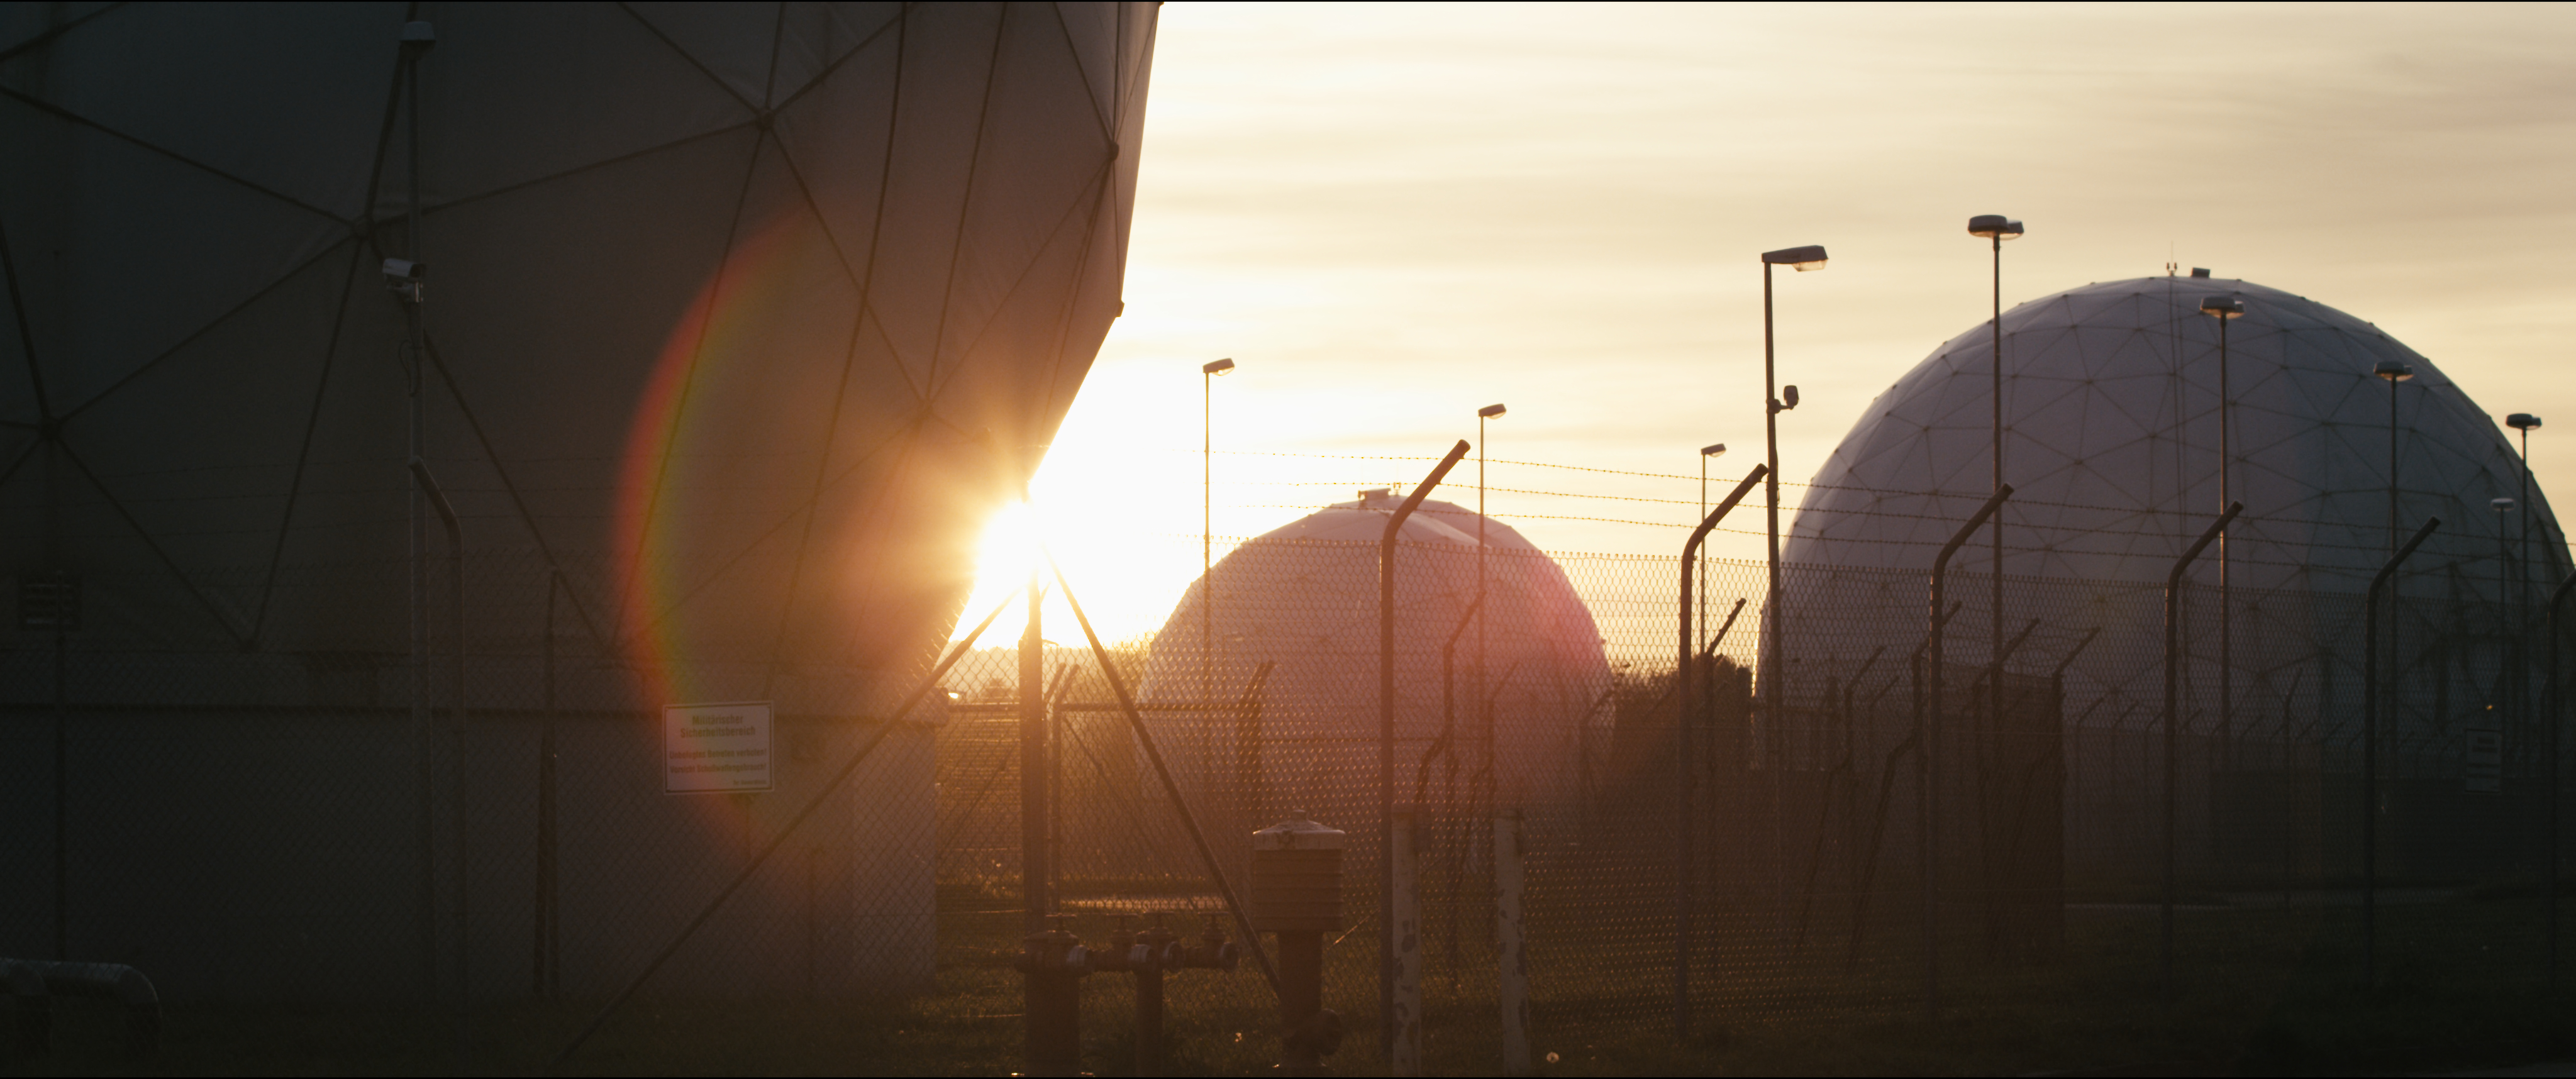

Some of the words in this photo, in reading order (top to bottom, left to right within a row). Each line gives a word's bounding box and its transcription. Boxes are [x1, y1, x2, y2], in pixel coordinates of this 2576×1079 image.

[692, 714, 743, 724] Militärischer
[680, 726, 755, 738] Sicherheitsbereich
[708, 750, 735, 758] Betreten
